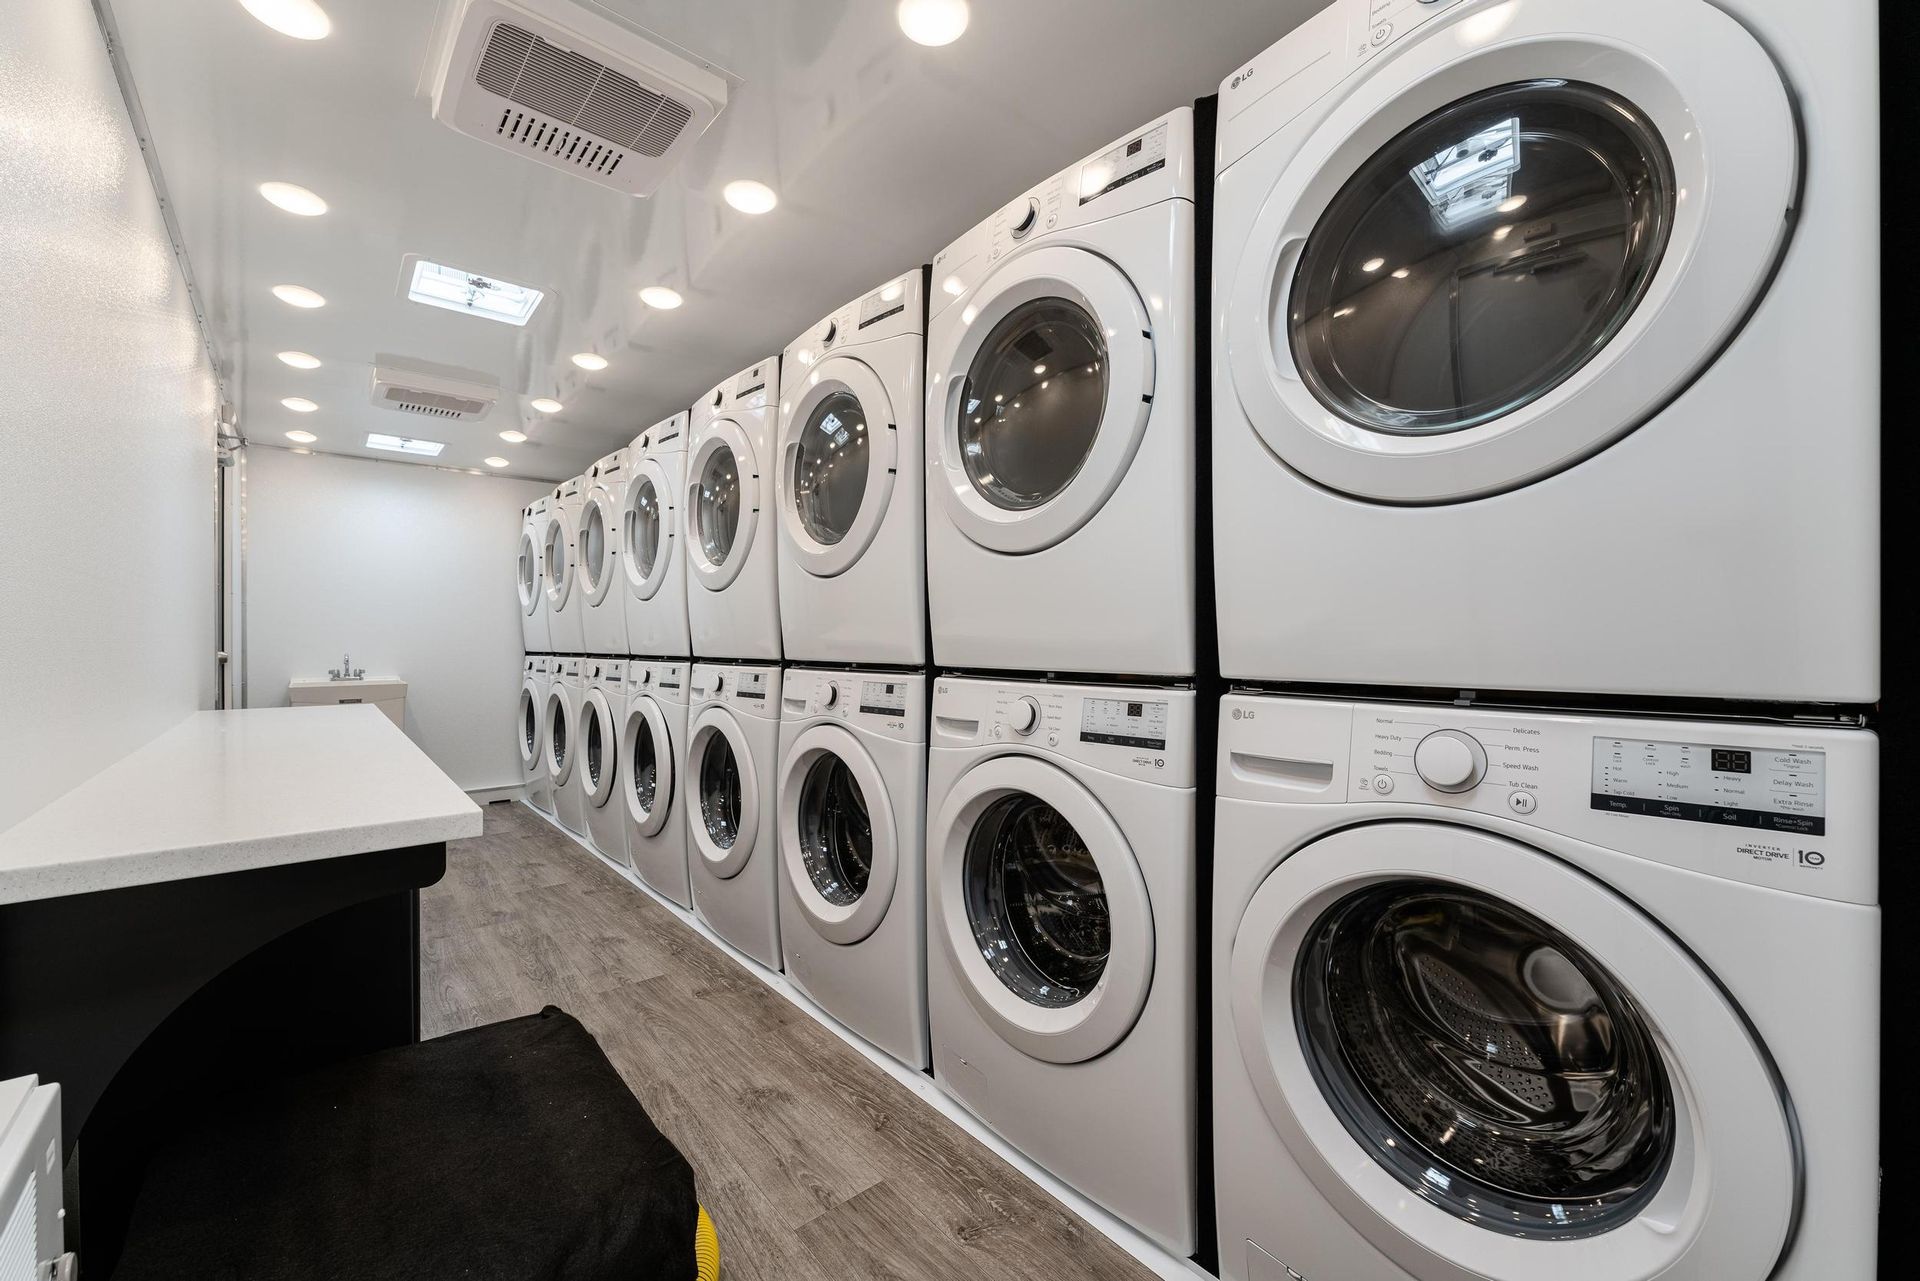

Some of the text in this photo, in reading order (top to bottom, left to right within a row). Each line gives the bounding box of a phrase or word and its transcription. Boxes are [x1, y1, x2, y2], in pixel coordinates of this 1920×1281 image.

[1242, 68, 1254, 81] LG
[1243, 710, 1255, 719] LG
[1513, 727, 1541, 736] Delicates
[1374, 749, 1393, 757] Bedding
[1522, 745, 1540, 753] Press
[1774, 756, 1791, 764] Cold
[1503, 762, 1521, 770] Speed
[1509, 780, 1538, 790] Tub Clean
[1773, 778, 1815, 788] Delay Wash
[1609, 800, 1628, 809] Temp.
[1773, 798, 1815, 808] Extra Rinse
[1664, 804, 1680, 812] Spin
[1722, 813, 1737, 821] Soil
[1745, 843, 1781, 851] INVERTER
[1736, 847, 1790, 860] DIRECT DRIVE
[1798, 850, 1825, 866] 10
